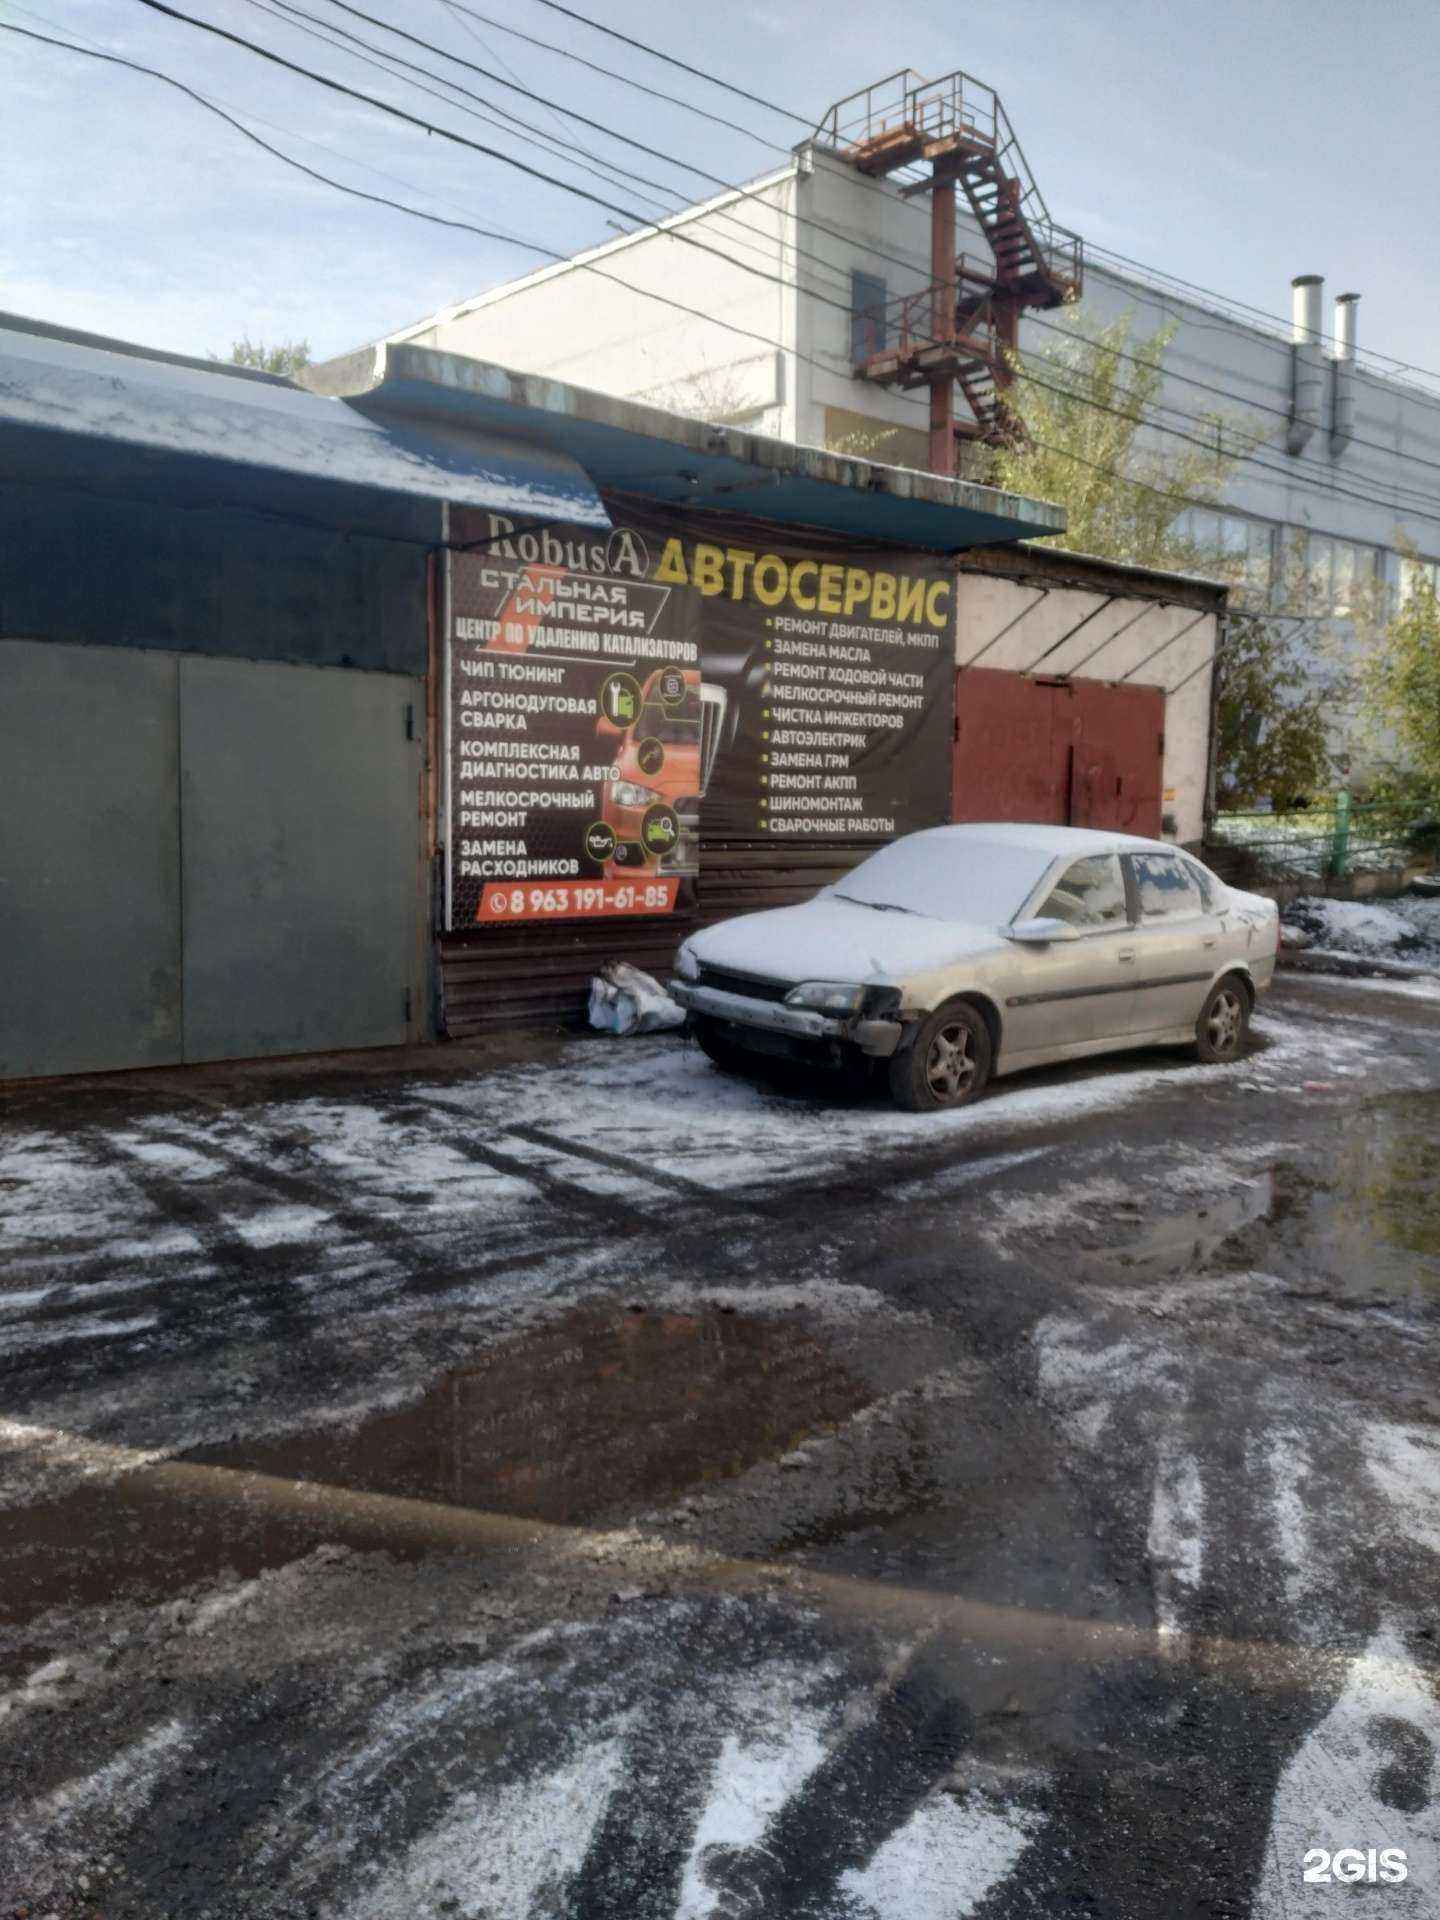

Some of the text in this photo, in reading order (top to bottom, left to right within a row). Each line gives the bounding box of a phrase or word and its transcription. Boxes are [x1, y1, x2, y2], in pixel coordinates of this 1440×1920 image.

[481, 569, 627, 604] СТАЛЬНАЯ
[653, 537, 950, 627] АВТОСЕРВИС
[515, 597, 647, 628] ИМПЕРИЯ
[456, 617, 698, 661] ЦЕНТР ПО УДАЛЕНИЮ КАТАЛИЗАТОРОВ
[775, 616, 939, 649] РЕМОНТ ДВИГАТЕЛЕЙ, МКПП
[774, 640, 871, 663] ЗАМЕНА МАСЛА
[460, 660, 565, 684] ЧИП ТЮНИНГ
[774, 662, 924, 689] РЕМОНТ ХОДОВОЙ ЧАСТИ
[460, 690, 597, 715] АРГОНОДУГОВАЯ
[773, 685, 924, 709] МЕЛКОСРОЧНЫЙ РЕМОНТ
[460, 711, 528, 730] СВАРКА
[772, 708, 904, 728] ЧИСТКА ИНЖЕКТОРОВ
[772, 730, 867, 748] АВТОЭЛЕКТРИК
[460, 740, 580, 761] КОМПЛЕКСНАЯ
[771, 751, 850, 768] ЗАМЕНА ГРМ
[460, 761, 621, 782] ДИАГНОСТИКА АВТО
[770, 774, 857, 790] РЕМОНТ АКПП
[460, 789, 595, 808] МЕЛКОСРОЧНЫЙ
[770, 796, 863, 811] ШИНОМОНТАЖ
[460, 811, 528, 827] РЕМОНТ
[770, 818, 894, 833] СВАРОЧНЫЕ РАБОТЫ
[460, 840, 528, 856] ЗАМЕНА
[460, 858, 579, 878] РАСХОДНИКОВ
[510, 885, 668, 913] 8 963 191-61-85
